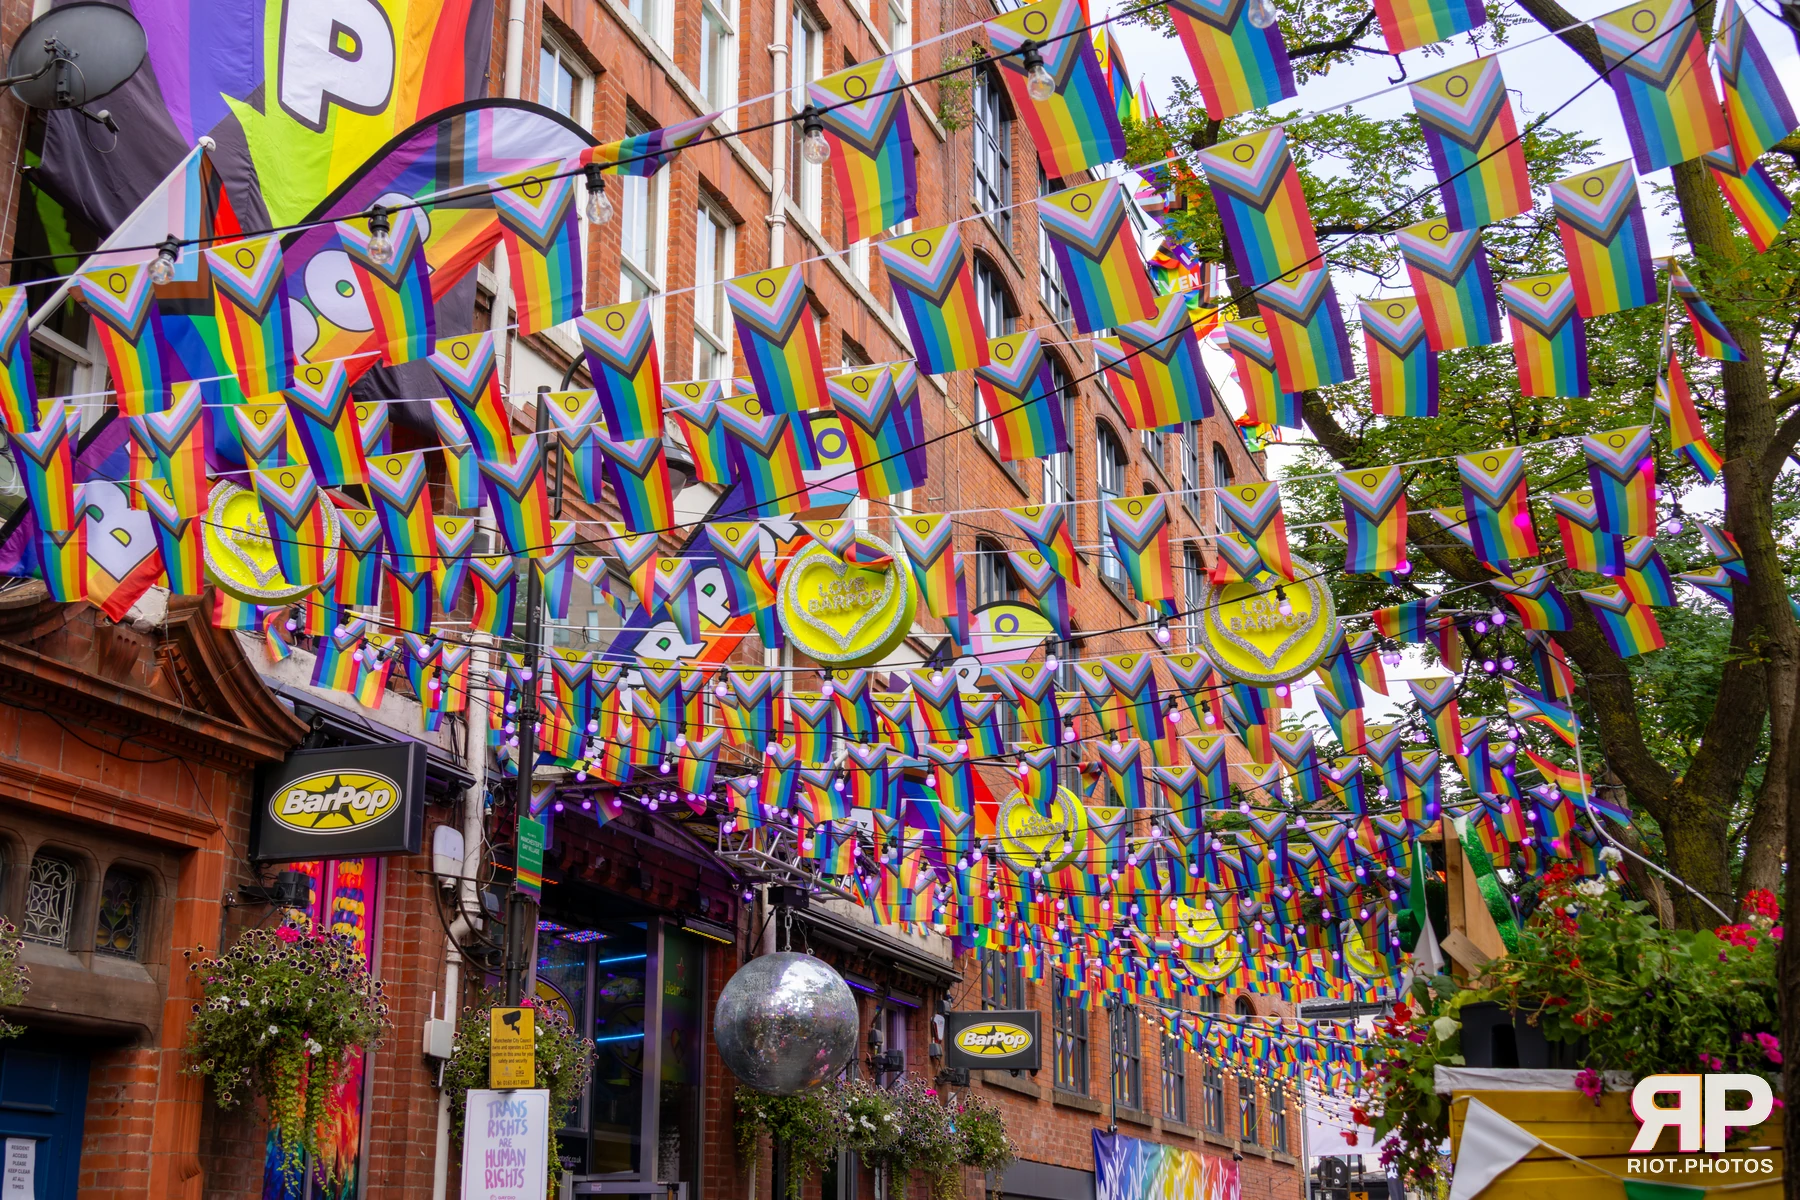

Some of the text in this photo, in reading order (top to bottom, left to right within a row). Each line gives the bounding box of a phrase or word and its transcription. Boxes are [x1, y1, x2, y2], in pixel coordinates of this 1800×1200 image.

[818, 576, 868, 597] LOVE
[807, 589, 882, 613] BARPOP
[1241, 597, 1290, 615] LOV
[1230, 611, 1308, 631] BARPOP
[281, 786, 391, 816] BarPop
[963, 1032, 1026, 1049] BarPop
[487, 1100, 528, 1118] TRANS
[488, 1119, 528, 1138] RIGHTS
[499, 1138, 512, 1147] ARE
[485, 1148, 526, 1168] HUMAN
[485, 1168, 525, 1189] RIGHTS
